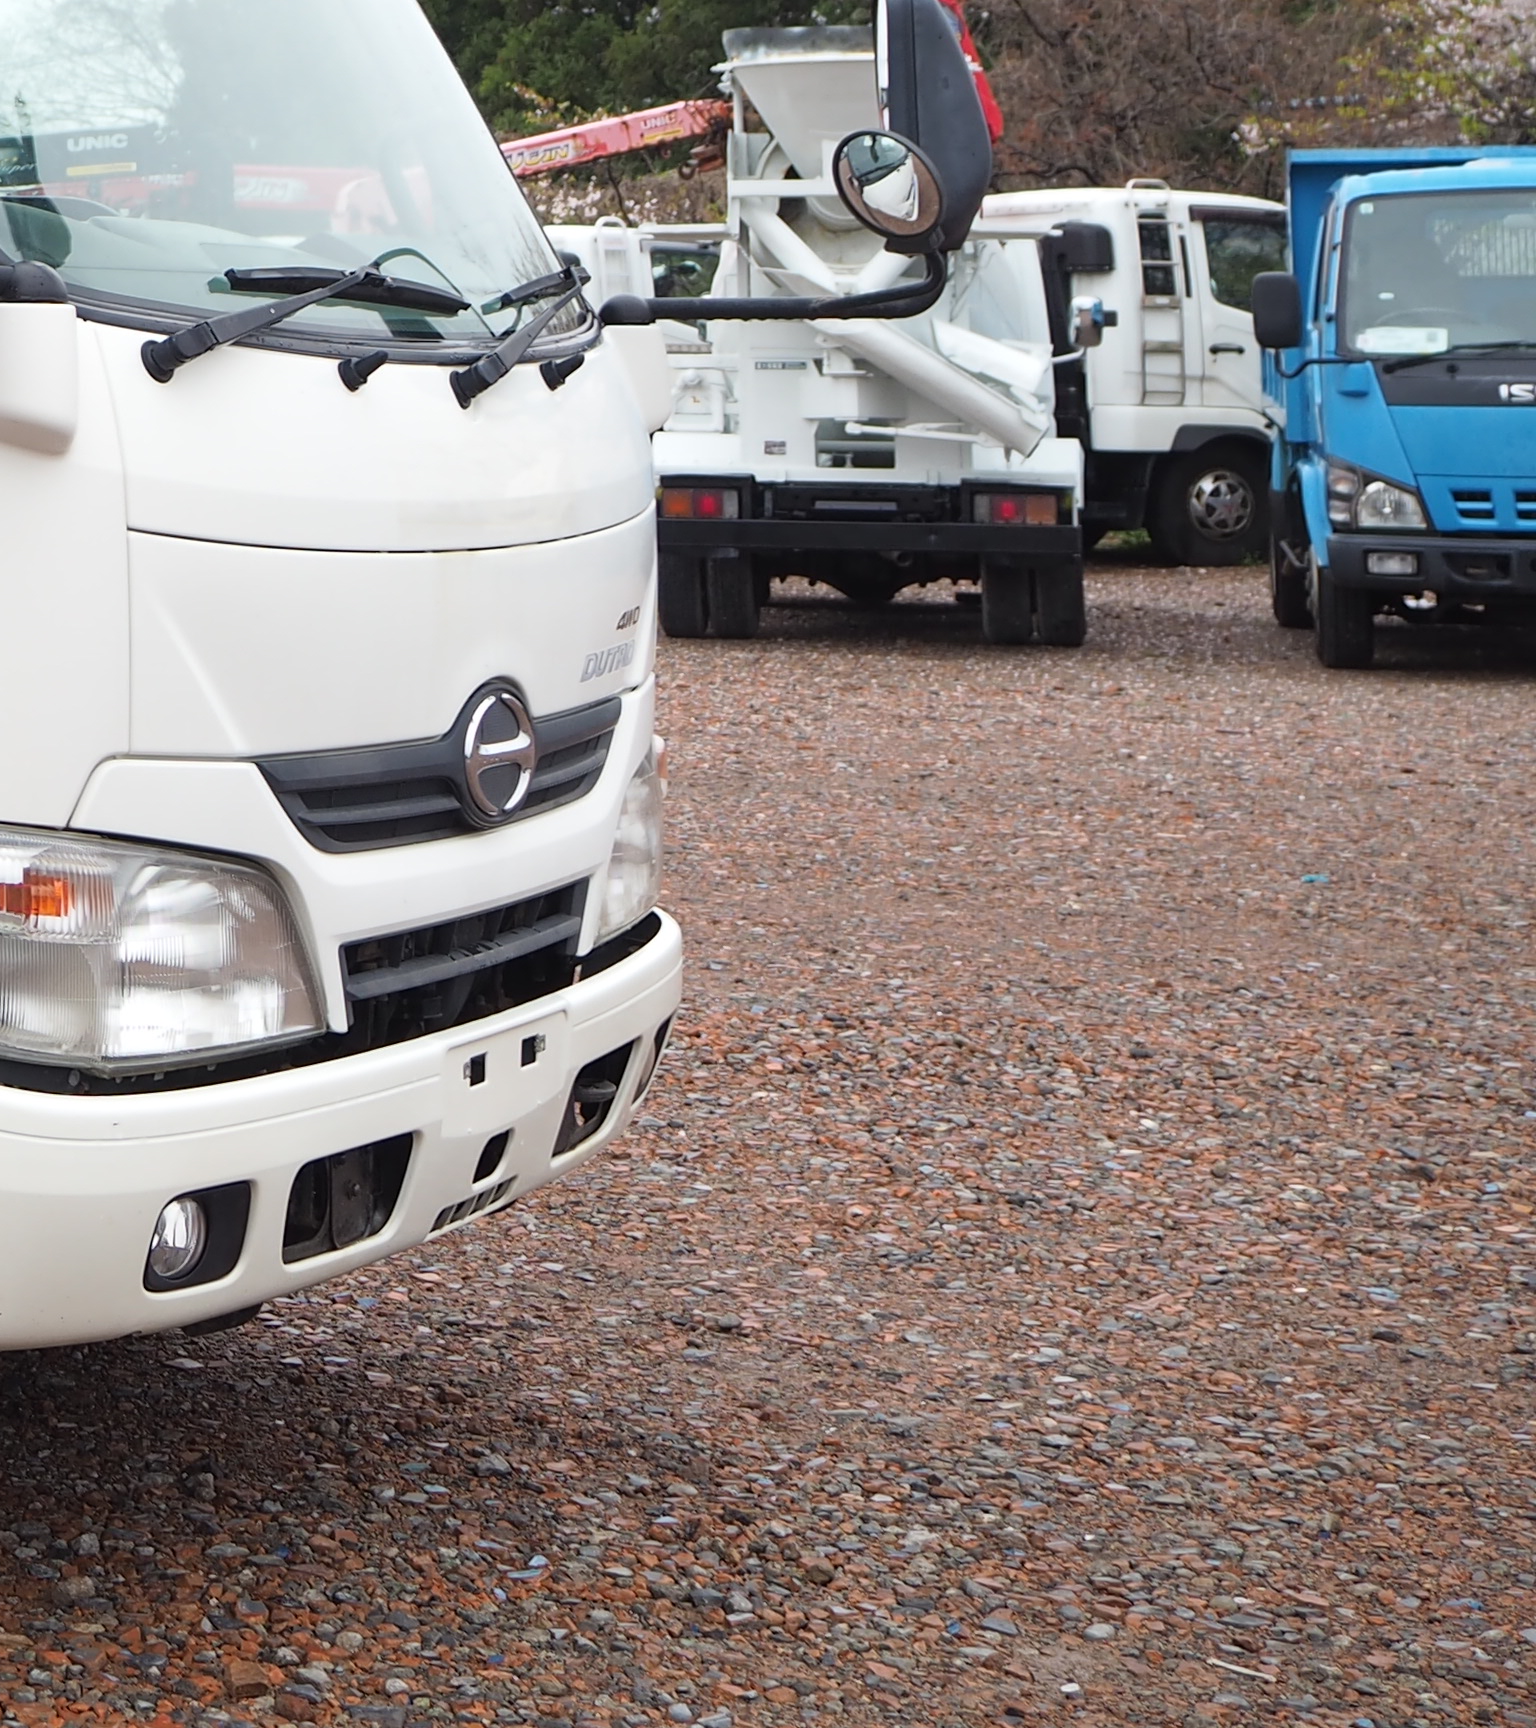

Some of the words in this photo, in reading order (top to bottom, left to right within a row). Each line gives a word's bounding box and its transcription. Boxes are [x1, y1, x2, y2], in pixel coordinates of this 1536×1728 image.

[640, 114, 677, 130] UNIC
[66, 133, 128, 152] UNIC
[1498, 383, 1536, 401] IS
[615, 605, 641, 631] 4WD
[580, 638, 636, 684] DUTRO
